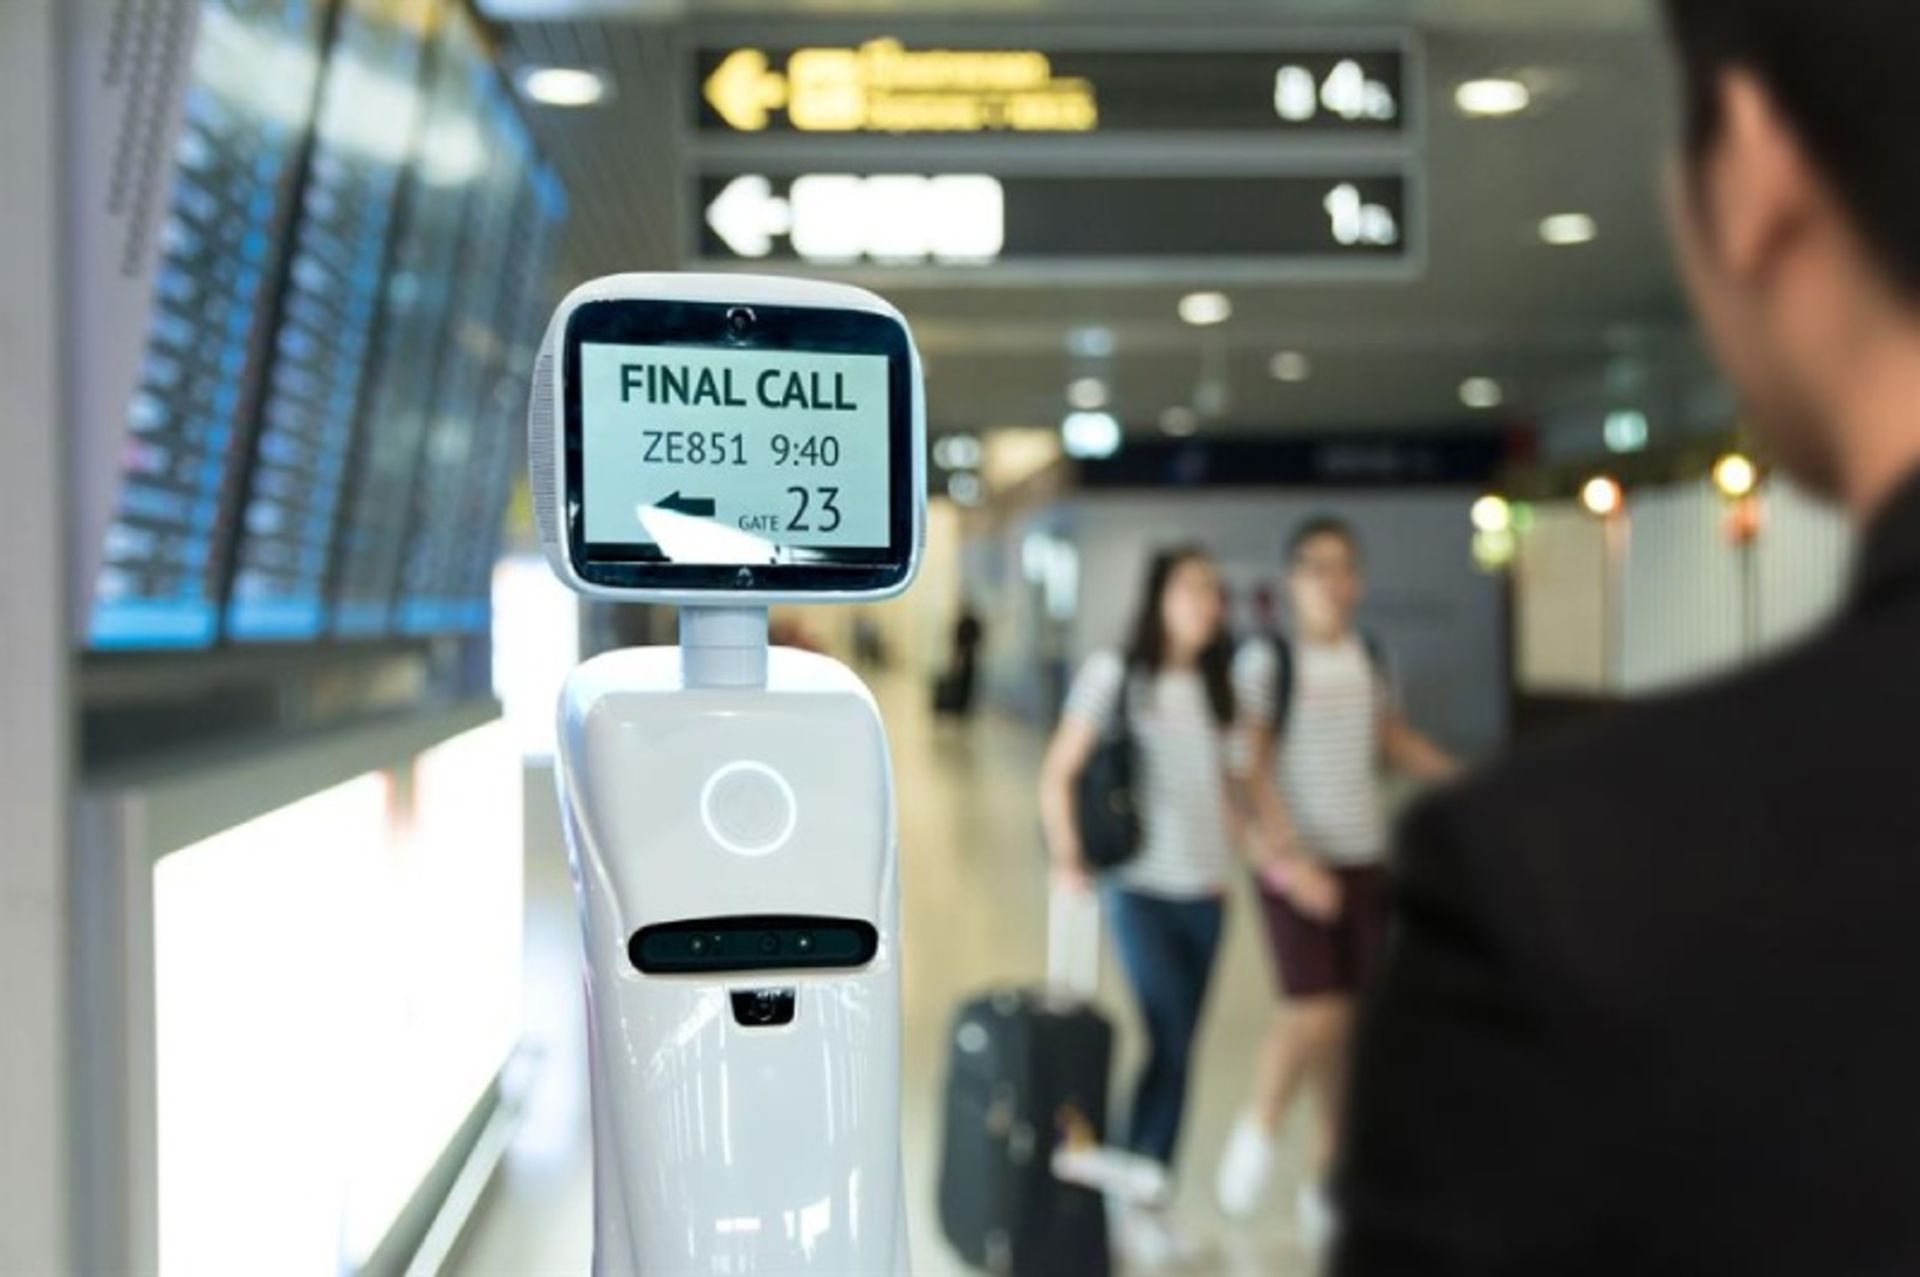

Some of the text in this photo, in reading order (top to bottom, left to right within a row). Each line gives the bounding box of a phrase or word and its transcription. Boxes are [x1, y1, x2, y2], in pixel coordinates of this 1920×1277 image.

[620, 363, 858, 411] FINAL CALL
[643, 431, 840, 467] ZE851 9:40
[738, 486, 842, 533] GATE 23
